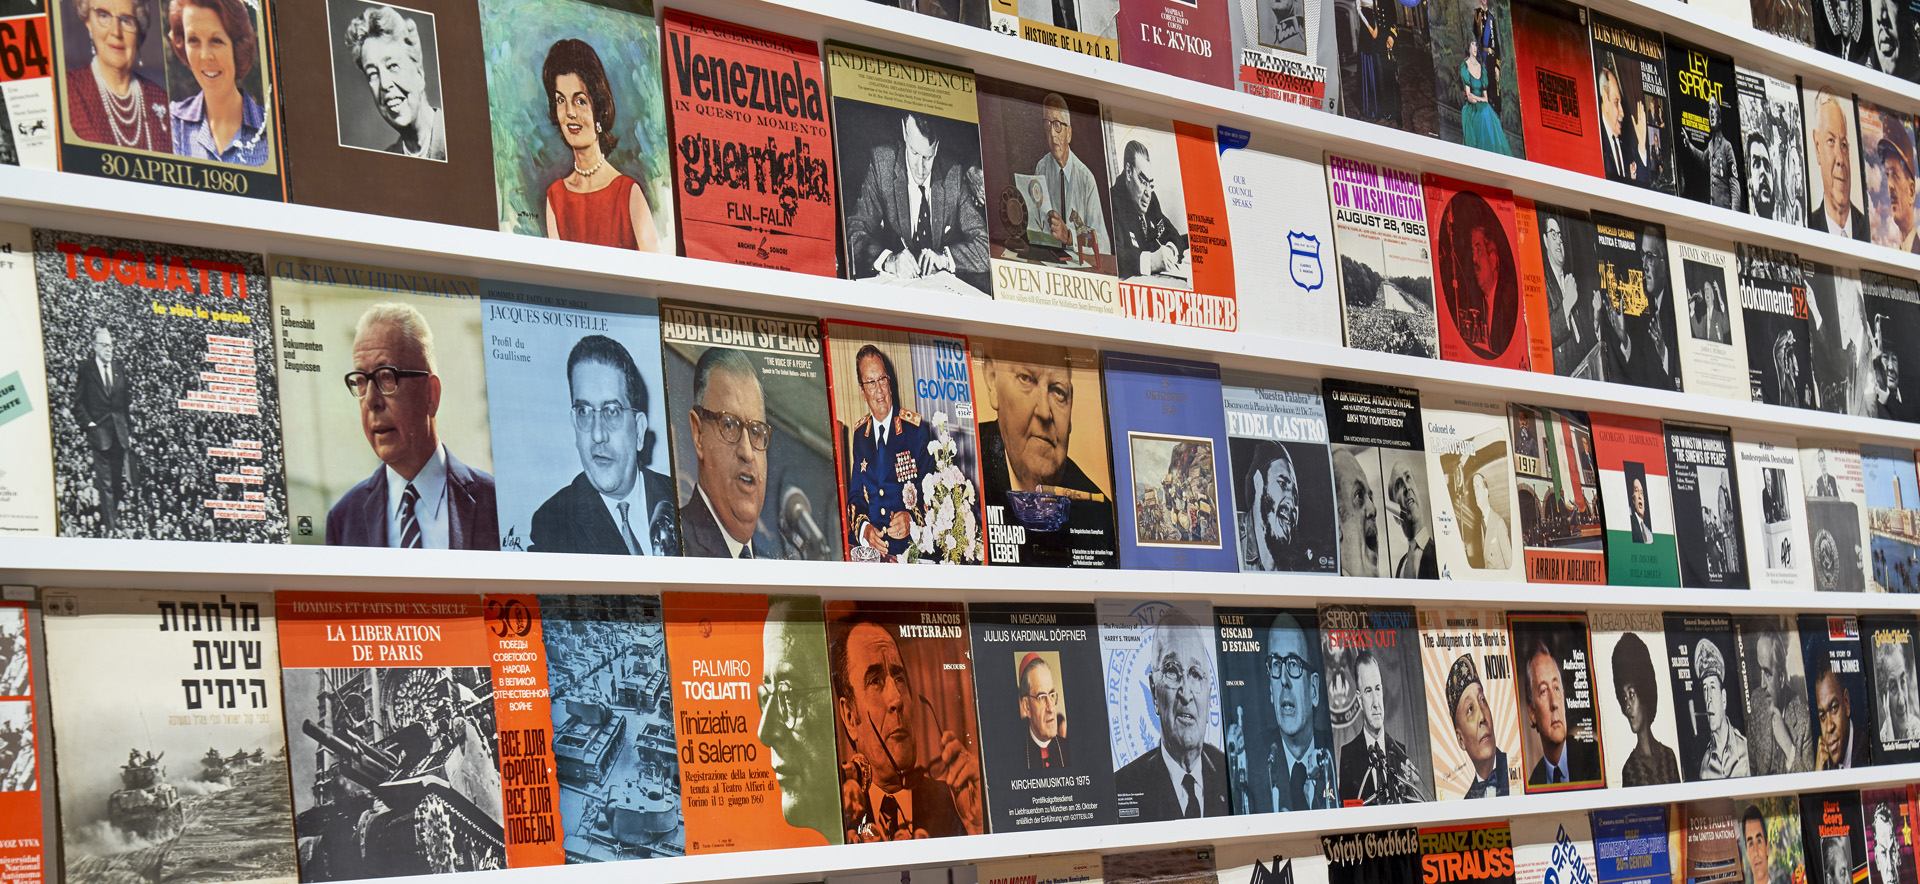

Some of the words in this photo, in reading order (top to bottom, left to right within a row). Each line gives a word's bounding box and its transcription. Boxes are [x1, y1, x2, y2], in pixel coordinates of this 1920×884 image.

[690, 21, 709, 35] LA
[713, 27, 796, 54] GUERRIGLIA
[1140, 23, 1150, 42] Г.
[1152, 26, 1166, 46] К.
[1166, 30, 1212, 58] ЖУКОВ
[1688, 49, 1708, 77] LEY
[669, 31, 825, 122] Venezuela
[830, 49, 973, 94] INDEPENDENCE
[1642, 71, 1654, 84] PARA
[1655, 75, 1662, 86] LA
[1643, 81, 1667, 98] HISTORIA
[675, 100, 690, 112] IN
[695, 103, 752, 123] QUESTO
[757, 115, 828, 138] MOMENTO
[101, 152, 129, 177] 30
[132, 157, 200, 188] APRIL
[201, 170, 249, 195] 1980
[1233, 175, 1247, 186] OUR
[1330, 155, 1379, 189] FREEDOM
[1382, 167, 1421, 198] MARCH
[1228, 185, 1253, 198] COUNCIL
[1232, 199, 1253, 209] SPEAKS
[1333, 181, 1350, 208] ON
[1352, 185, 1425, 222] WASHINGTON
[1187, 213, 1215, 226] АКТУАЛЬНЫЕ
[1336, 209, 1381, 228] AUGUST
[1383, 219, 1400, 234] 28,
[1401, 221, 1426, 237] 1963
[1189, 223, 1209, 234] ВОПРОСЫ
[1191, 244, 1208, 255] РАБОТЫ
[1192, 254, 1204, 264] КПСС
[56, 242, 248, 299] TOGLIATTI
[276, 260, 339, 287] GUSTAV
[344, 268, 365, 289] W.
[368, 271, 474, 300] HEINEMANN
[998, 265, 1042, 298] SVEN
[1046, 273, 1113, 304] JERRING
[1740, 278, 1795, 317] dokumente
[1794, 290, 1807, 318] 62
[153, 301, 166, 314] la
[169, 304, 193, 317] vita
[196, 306, 209, 319] la
[212, 311, 251, 323] parola
[281, 305, 290, 316] Ein
[281, 317, 315, 330] Lebensbild
[490, 305, 540, 324] JACQUES
[543, 311, 609, 333] SOUSTELLE
[283, 327, 289, 337] in
[664, 308, 710, 343] ABBA
[710, 313, 755, 347] EBAN
[756, 318, 821, 354] SPEAKS
[283, 338, 323, 352] Dokumenten
[492, 335, 512, 348] Profil
[515, 338, 525, 350] du
[284, 350, 296, 360] und
[493, 349, 531, 364] Gaullisme
[934, 340, 964, 362] TITO
[285, 359, 321, 373] Zeugnissen
[936, 361, 967, 382] NAM
[917, 378, 969, 403] GOVORI
[1162, 404, 1176, 415] 1940
[1227, 411, 1273, 438] FIDEL
[1274, 415, 1326, 443] CASTRO
[1428, 422, 1449, 434] Colonel
[1449, 425, 1456, 435] de
[1599, 430, 1625, 444] GIORGIO
[1628, 433, 1659, 448] ALMIRANTE
[1518, 455, 1537, 474] 1917
[987, 506, 1005, 525] MIT
[988, 525, 1026, 545] ERHARD
[990, 544, 1020, 564] LEBEN
[158, 594, 261, 632] מלחמת
[293, 601, 342, 614] HOMMES
[345, 602, 355, 614] ET
[362, 602, 392, 614] FAITS
[395, 603, 409, 614] DU
[1010, 614, 1018, 624] IN
[1019, 614, 1057, 624] MEMORIAM
[1103, 622, 1111, 630] The
[1111, 622, 1132, 632] Presidency
[1132, 622, 1138, 630] of
[1220, 615, 1244, 626] VALERY
[326, 625, 346, 642] LA
[351, 625, 441, 642] LIBERATION
[899, 624, 963, 639] MITTERRAND
[983, 630, 1010, 642] JULIUS
[1011, 629, 1049, 642] KARDINAL
[1049, 627, 1087, 641] DÖPFNER
[1104, 635, 1118, 643] HARRY
[1119, 635, 1123, 643] S.
[1220, 627, 1253, 639] GISCARD
[1328, 630, 1373, 647] SPEAKS
[1375, 629, 1397, 647] OUT
[499, 640, 528, 651] ПОБЕДЫ
[1229, 641, 1260, 652] ESTAING
[1423, 633, 1434, 648] The
[1436, 633, 1464, 651] Judgment
[1466, 632, 1471, 647] of
[1472, 633, 1482, 647] the
[1482, 633, 1500, 647] World
[1500, 632, 1506, 647] is
[193, 640, 262, 670] ששת
[352, 645, 373, 661] DE
[379, 644, 423, 661] PARIS
[493, 652, 537, 662] СОВЕТСКОГО
[502, 664, 531, 674] НАРОДА
[692, 659, 751, 677] PALMIRO
[943, 663, 967, 671] DISCOURS
[1830, 660, 1841, 673] TOM
[1841, 660, 1860, 673] SKINNER
[499, 678, 505, 686] В
[506, 677, 536, 686] ВЕЛИКОЙ
[182, 678, 268, 709] הימים
[493, 688, 549, 699] ОТЕЧЕСТВЕННОЙ
[682, 681, 751, 700] TOGLIATTI
[1575, 690, 1589, 699] unser
[509, 702, 533, 711] ВОЙНЕ
[1566, 698, 1590, 709] Vaterland
[680, 710, 748, 736] l'iniziativa
[500, 730, 522, 757] ВСЕ
[523, 729, 547, 758] ДЛЯ
[681, 739, 695, 764] di
[698, 739, 757, 764] Salerno
[503, 757, 549, 787] ФРОНТА
[685, 770, 728, 784] Registrazione
[731, 769, 746, 781] della
[748, 768, 770, 780] lezione
[690, 783, 710, 795] tenuta
[713, 783, 719, 794] al
[722, 781, 742, 794] Teatro
[745, 779, 766, 793] Alfieri
[768, 780, 775, 791] di
[1010, 776, 1075, 791] KIRCHENMUSIKTAG
[1075, 775, 1091, 786] 1975
[505, 787, 527, 815] ВСЕ
[529, 786, 552, 815] ДЛЯ
[686, 795, 708, 808] Torino
[711, 795, 717, 804] il
[727, 794, 750, 808] giugno
[751, 793, 764, 805] 1960
[1823, 813, 1843, 826] Georg
[507, 815, 556, 845] ПОБЕДЫ
[1819, 825, 1850, 838] Kiesinger
[1420, 831, 1469, 855] FRANZ
[1471, 827, 1511, 850] JOSEF
[5, 863, 40, 872] Nacional
[1421, 846, 1516, 884] STRAUSS
